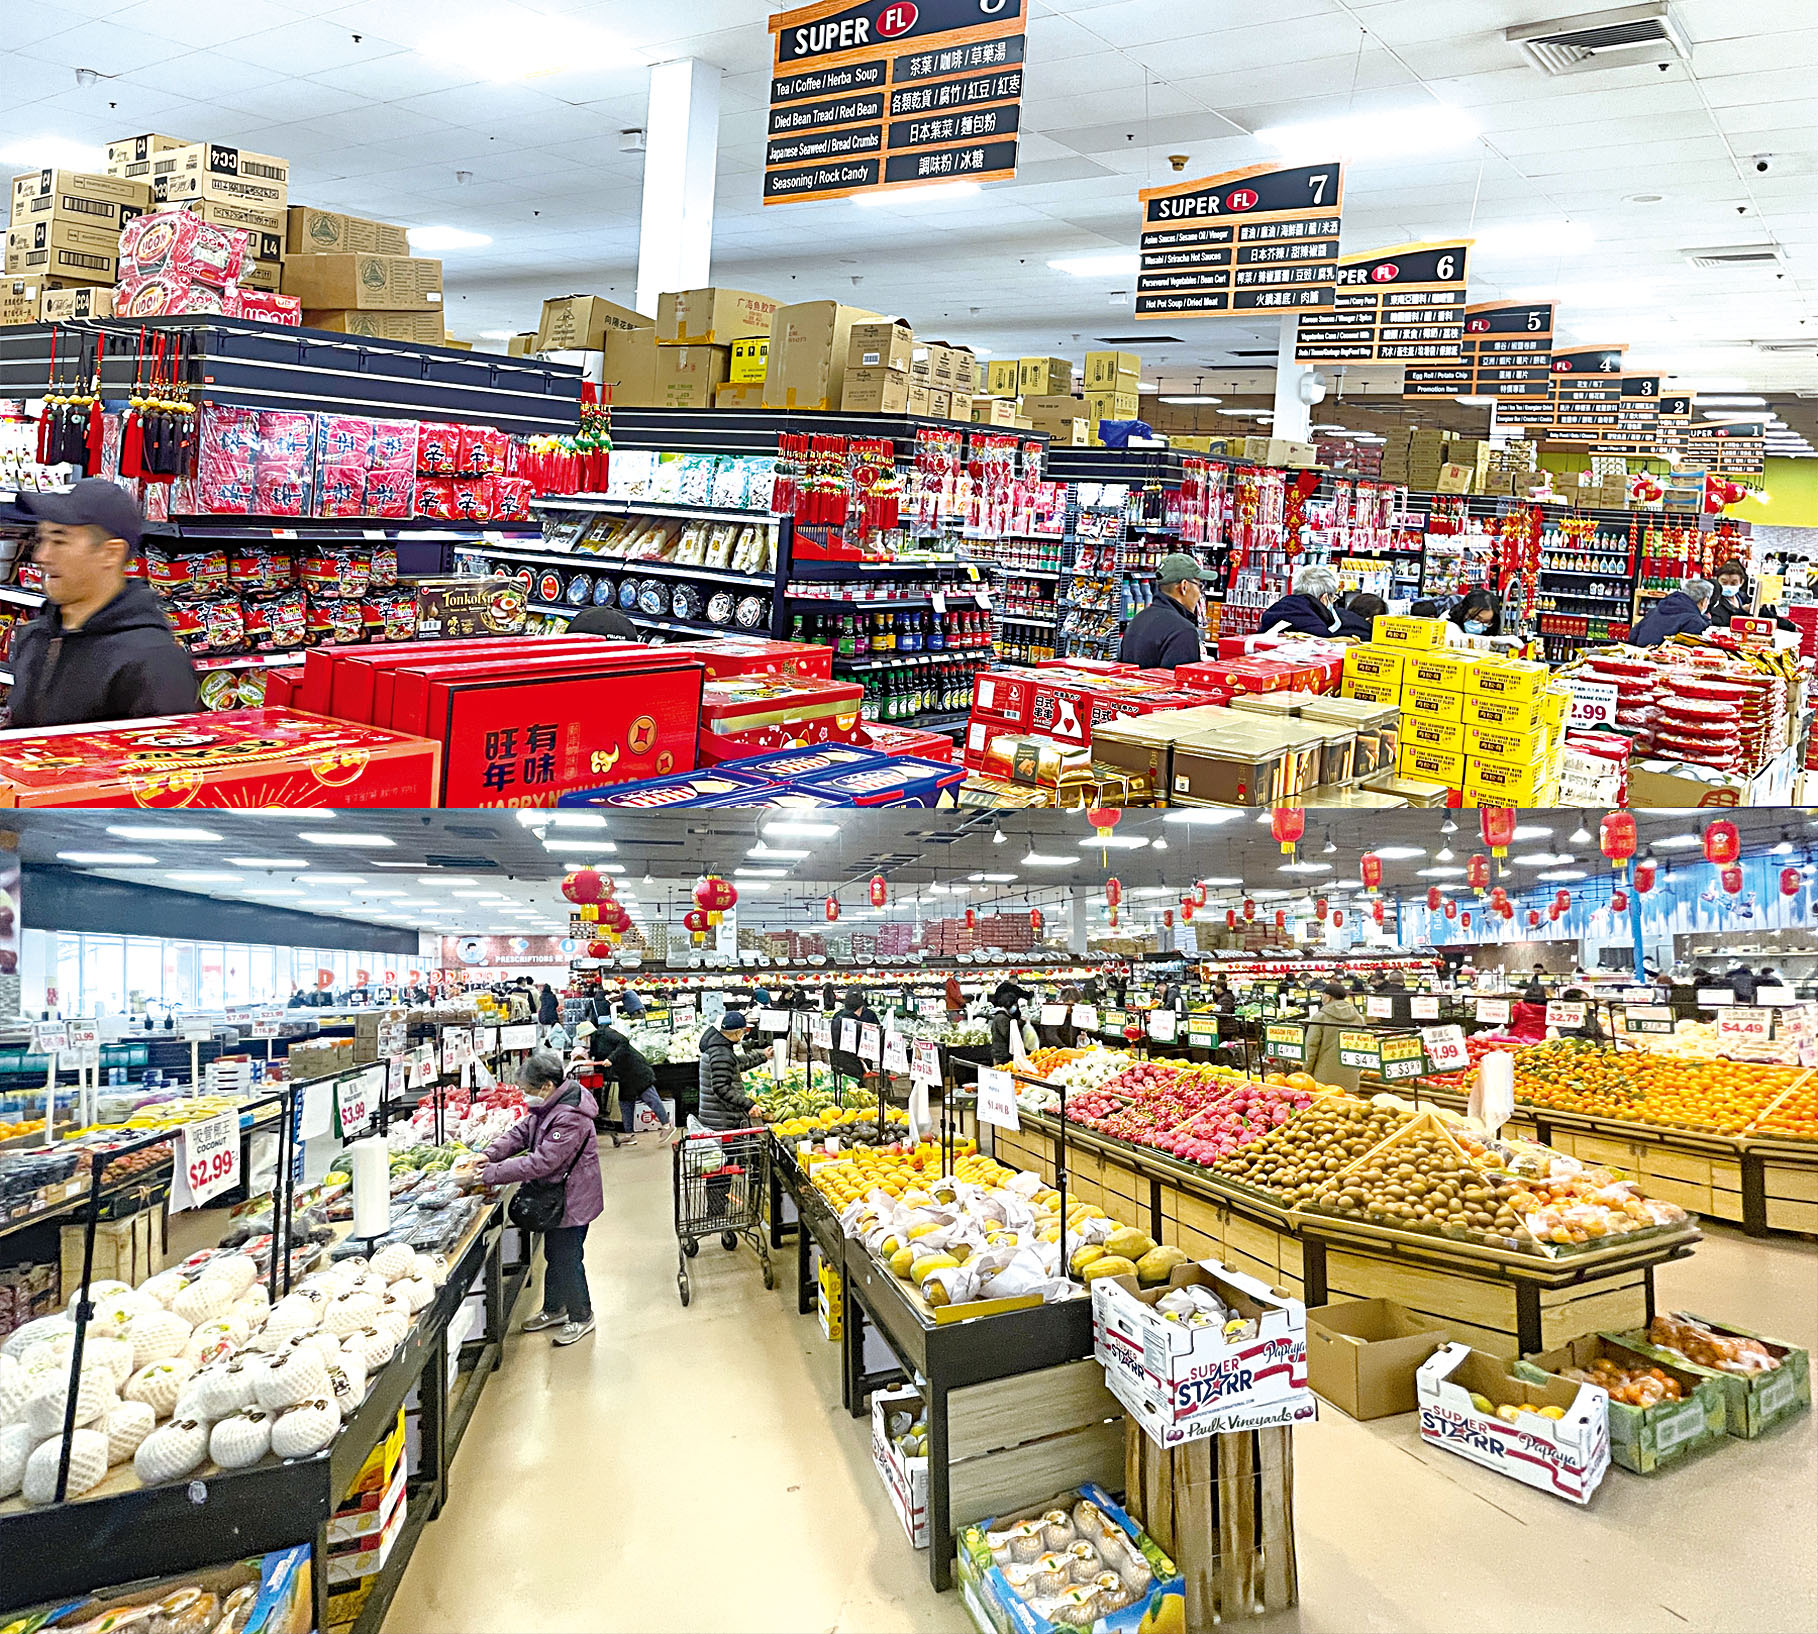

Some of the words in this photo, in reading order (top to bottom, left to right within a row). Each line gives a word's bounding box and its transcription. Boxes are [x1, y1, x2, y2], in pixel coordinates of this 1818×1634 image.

[794, 17, 870, 55] SUPER
[885, 7, 906, 31] FL
[910, 55, 933, 77] 茶葉
[940, 50, 963, 71] 咖啡
[970, 41, 1006, 65] 草藥湯
[776, 82, 790, 96] Tea
[795, 77, 821, 93] Coffee
[827, 71, 852, 88] Herba
[855, 67, 878, 83] Soup
[892, 88, 933, 114] 各類乾貨
[939, 84, 962, 105] 腐竹
[967, 79, 990, 100] 紅豆
[774, 113, 791, 129] Died
[792, 112, 812, 126] Bean
[812, 106, 834, 123] Tread
[840, 105, 855, 119] Red
[857, 102, 878, 116] Bean
[910, 118, 953, 143] 日本紫菜
[769, 147, 799, 162] Japanese
[799, 140, 827, 157] Seaweed
[831, 136, 851, 152] Bread
[852, 133, 879, 150] Crumbs
[918, 153, 953, 176] 調味粉
[960, 148, 985, 170] 冰糖
[772, 173, 813, 190] Seasoning
[820, 168, 840, 184] Rock
[841, 165, 868, 181] Candy
[1158, 196, 1220, 218] SUPER
[1232, 192, 1251, 208] FL
[1308, 174, 1329, 205] 7
[263, 238, 278, 255] L4
[1190, 253, 1201, 262] Hot
[1200, 251, 1222, 262] Sauces
[178, 263, 201, 275] UDON
[1376, 266, 1392, 280] FL
[1436, 255, 1454, 280] 6
[1145, 300, 1156, 309] Hot
[1156, 299, 1167, 309] Pot
[1167, 298, 1183, 309] Soup
[1186, 297, 1203, 307] Dried
[1203, 296, 1219, 306] Meat
[244, 307, 297, 326] UDON
[1471, 320, 1484, 331] FL
[1527, 311, 1542, 331] 5
[1556, 362, 1568, 371] FL
[1600, 356, 1612, 372] 4
[1455, 371, 1468, 380] Chip
[1417, 385, 1445, 393] Promotion
[1640, 380, 1653, 396] 3
[1673, 400, 1685, 414] 2
[1690, 429, 1713, 437] UPER
[1751, 425, 1759, 437] 1
[1035, 696, 1054, 710] 日式
[495, 955, 553, 963] PRESCRIPTIONS
[1549, 1013, 1580, 1022] $2.79
[1721, 1022, 1763, 1033] $4.49
[1269, 1027, 1286, 1036] DRAGON
[1287, 1028, 1300, 1037] FRUIT
[341, 1101, 365, 1126] $3.99
[197, 1136, 227, 1154] COCONUT
[190, 1149, 232, 1191] $2.99
[1115, 1338, 1137, 1360] SUPER
[1263, 1339, 1306, 1364] Papaya
[1190, 1358, 1239, 1380] SUPER
[1186, 1416, 1226, 1438] Paulk
[1227, 1406, 1293, 1430] Vineyards
[1433, 1404, 1487, 1434] SUPER
[1518, 1430, 1578, 1467] Papaya
